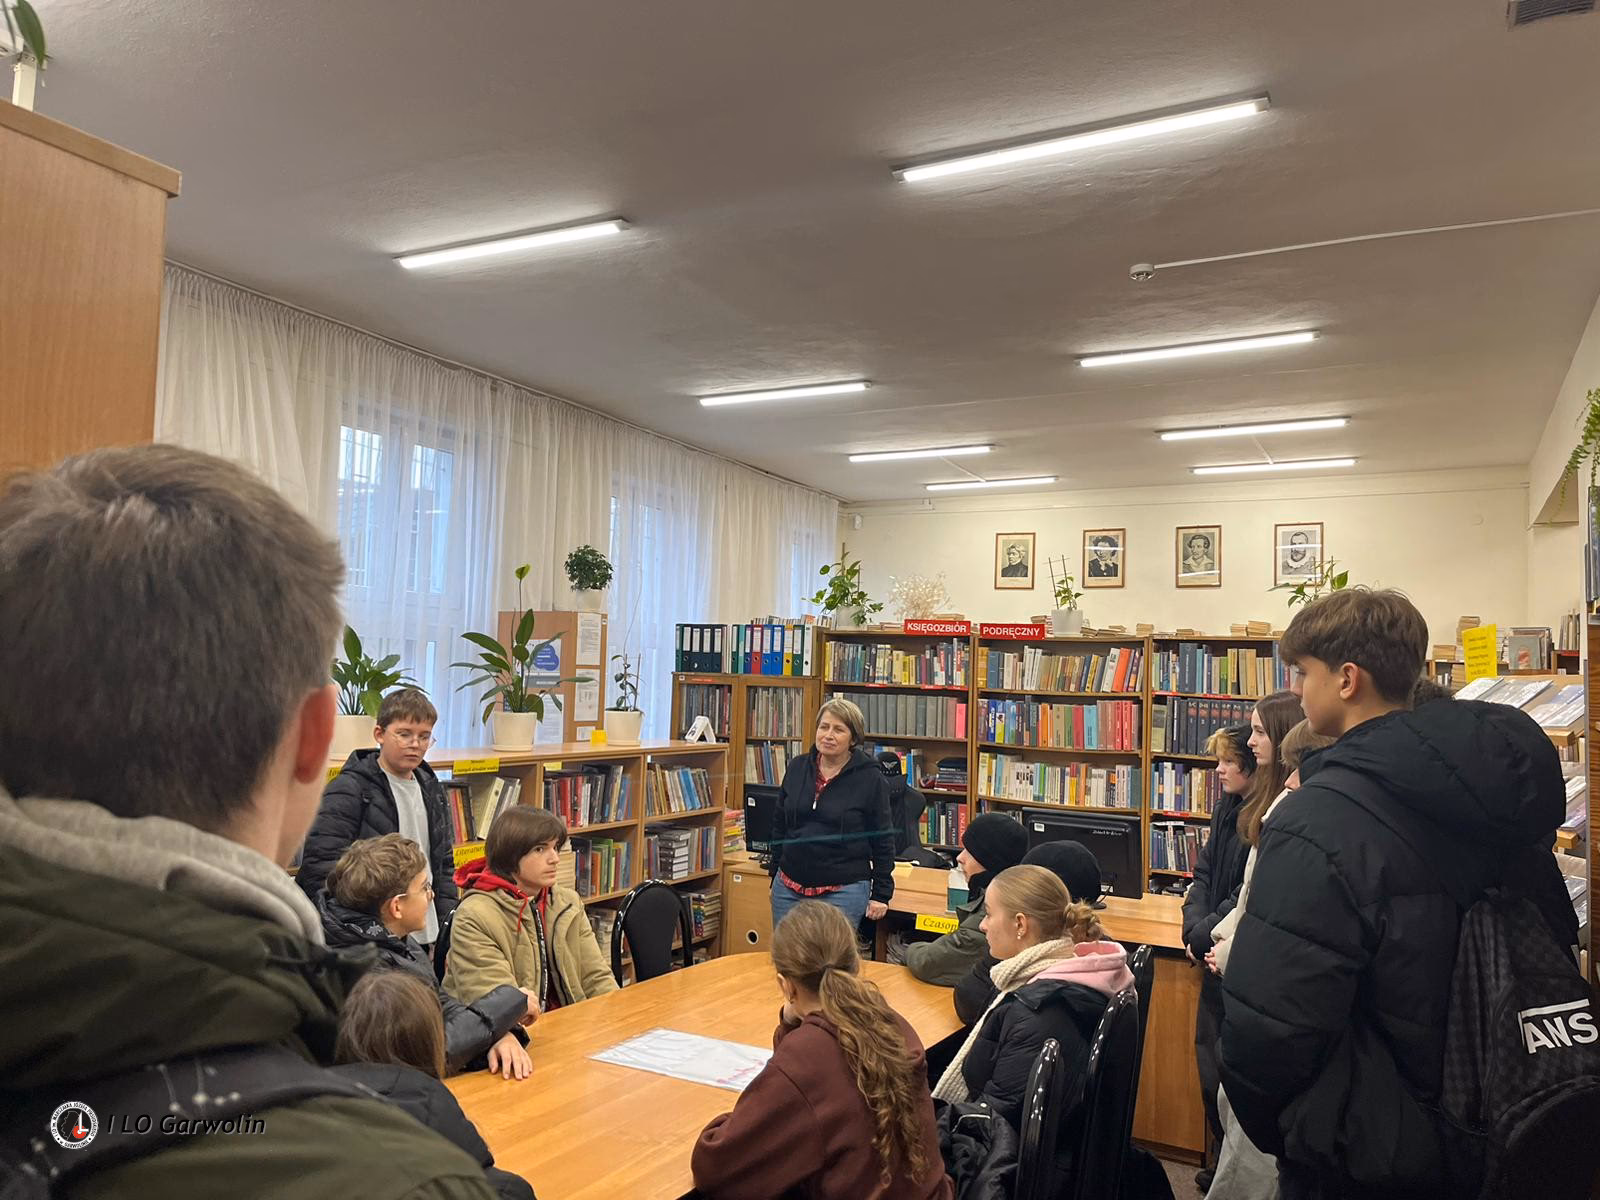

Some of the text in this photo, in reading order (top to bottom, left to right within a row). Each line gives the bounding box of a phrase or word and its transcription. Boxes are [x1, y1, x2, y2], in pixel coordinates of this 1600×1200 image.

[907, 621, 1041, 639] KSIĘGOZBIÓR PODRĘCZNY
[455, 846, 486, 857] Literatur
